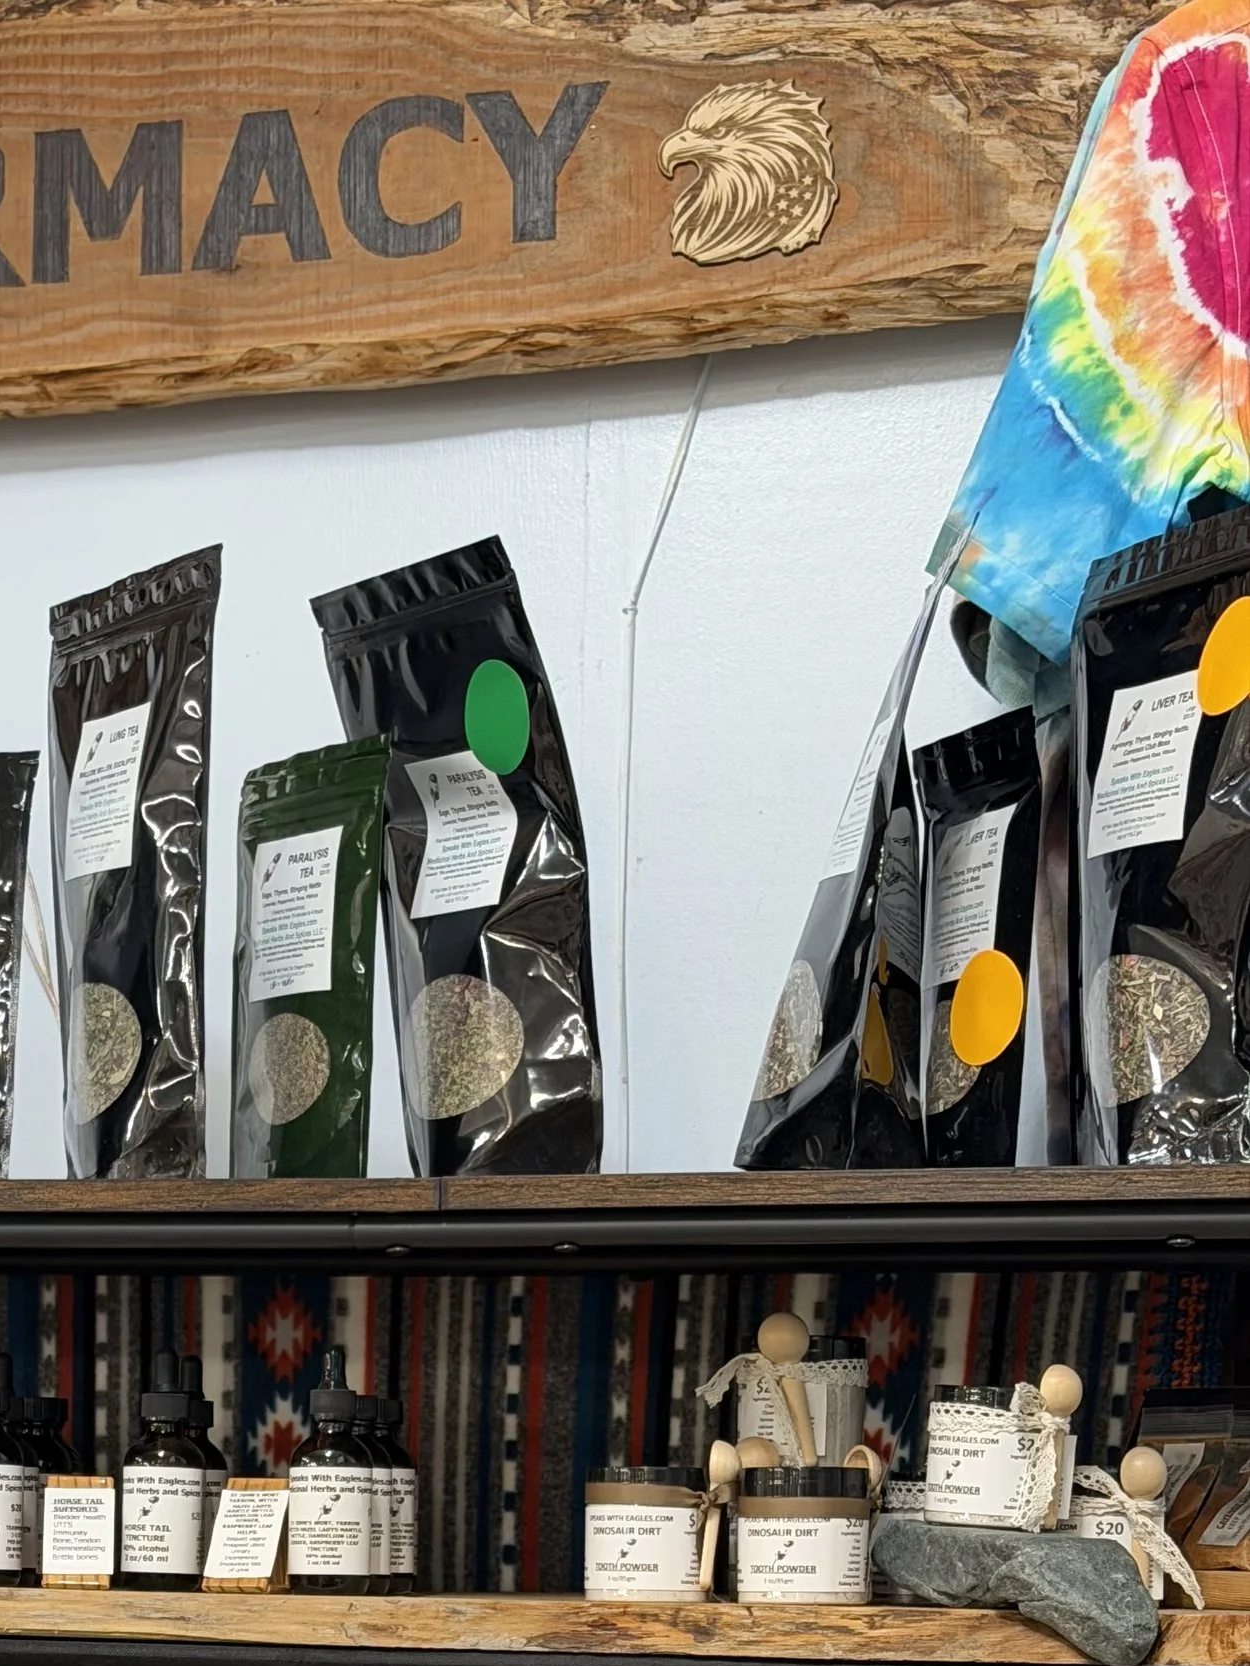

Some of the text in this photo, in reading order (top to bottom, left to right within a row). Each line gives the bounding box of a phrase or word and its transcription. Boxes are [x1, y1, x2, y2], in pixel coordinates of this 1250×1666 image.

[1151, 691, 1194, 711] LIVER TEA
[109, 725, 139, 743] LUNG TEA
[446, 770, 486, 796] PARALYSIS TEA
[288, 847, 329, 879] PARALYSIS TEA
[963, 1449, 986, 1458] DIRT
[944, 1484, 981, 1495] POWDER
[638, 1527, 661, 1536] DIRT
[795, 1528, 819, 1537] DIRT
[1095, 1521, 1124, 1535] $20
[619, 1563, 659, 1571] POWDER
[776, 1565, 817, 1573] POWDER
